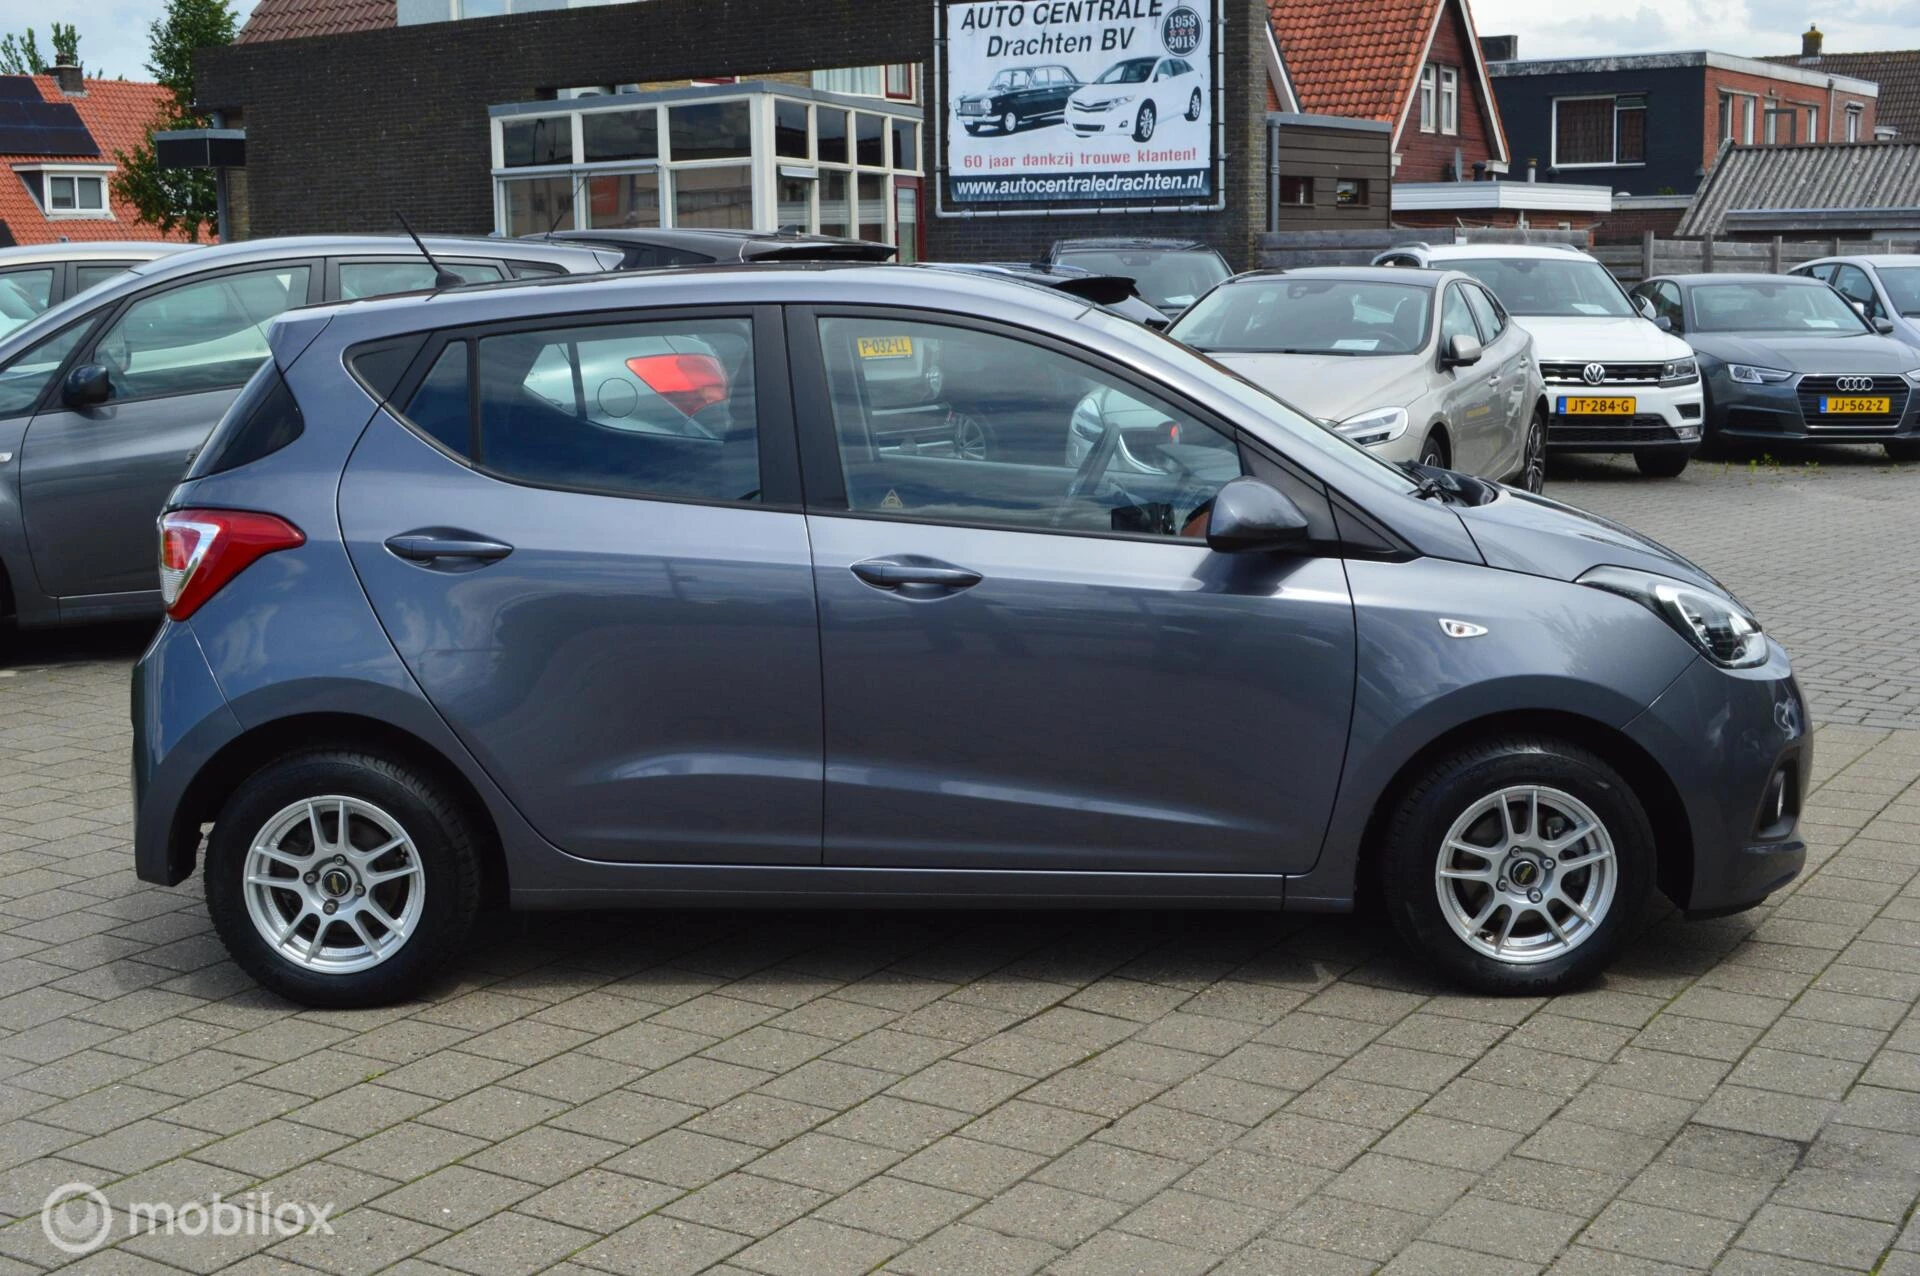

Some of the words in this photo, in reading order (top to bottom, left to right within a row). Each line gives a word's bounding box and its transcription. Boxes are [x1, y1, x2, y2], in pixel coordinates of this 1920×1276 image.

[961, 5, 1024, 30] AUTO
[1033, 0, 1162, 25] CENTRALE
[1169, 14, 1196, 29] 1958
[986, 33, 1092, 57] Drachten
[1101, 27, 1135, 51] BV
[1168, 35, 1196, 49] 2018
[963, 155, 983, 168] 60
[989, 154, 1016, 169] jaar
[1022, 152, 1074, 167] dankzij
[1080, 152, 1131, 165] trouwe
[1137, 147, 1196, 162] klanten!
[957, 171, 1204, 195] www.autocentraledrachten.nl
[1571, 400, 1629, 412] JT-284-G
[1831, 399, 1883, 411] JJ-562-Z
